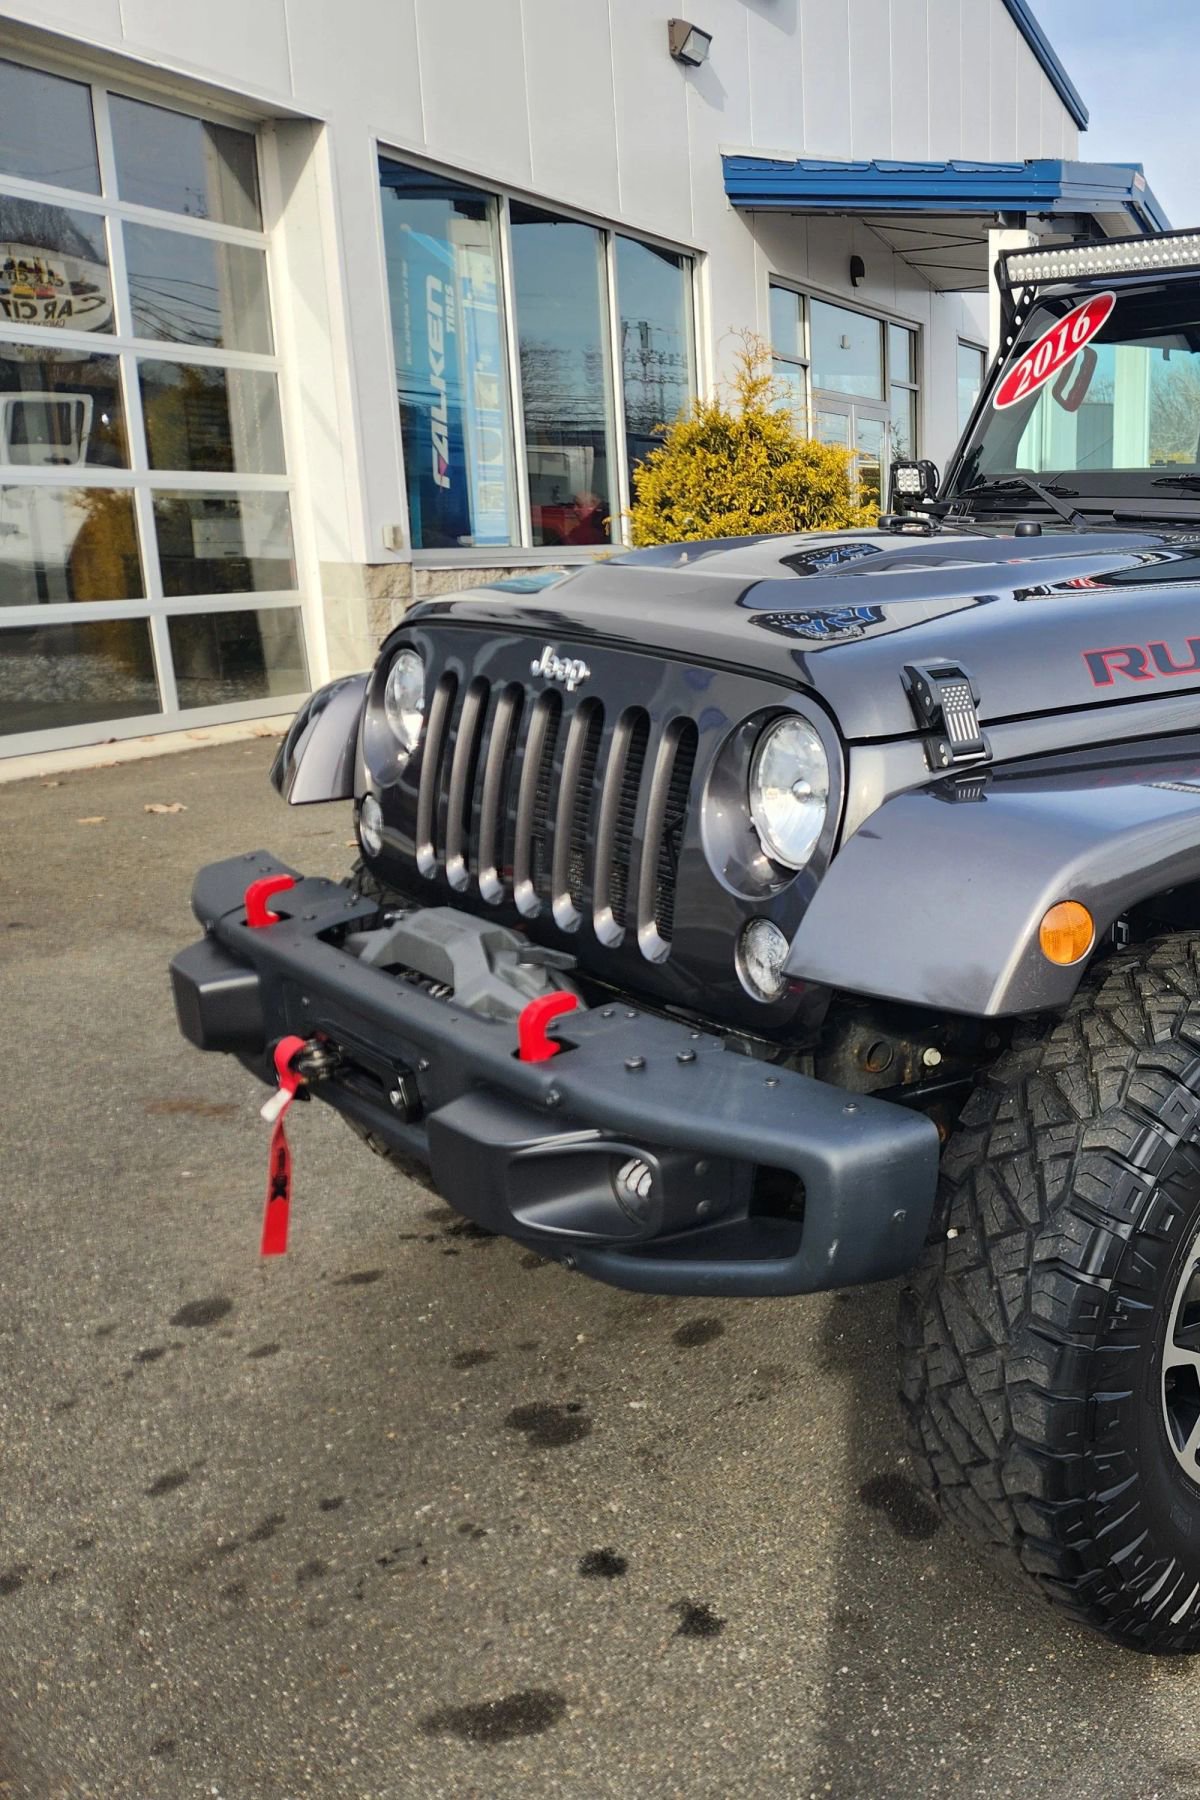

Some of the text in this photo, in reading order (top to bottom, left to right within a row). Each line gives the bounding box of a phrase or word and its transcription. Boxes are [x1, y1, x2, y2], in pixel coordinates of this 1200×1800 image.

[445, 284, 456, 333] TIRES
[426, 274, 451, 489] FALKEN
[1013, 302, 1092, 400] 2016
[530, 646, 590, 691] Jeep
